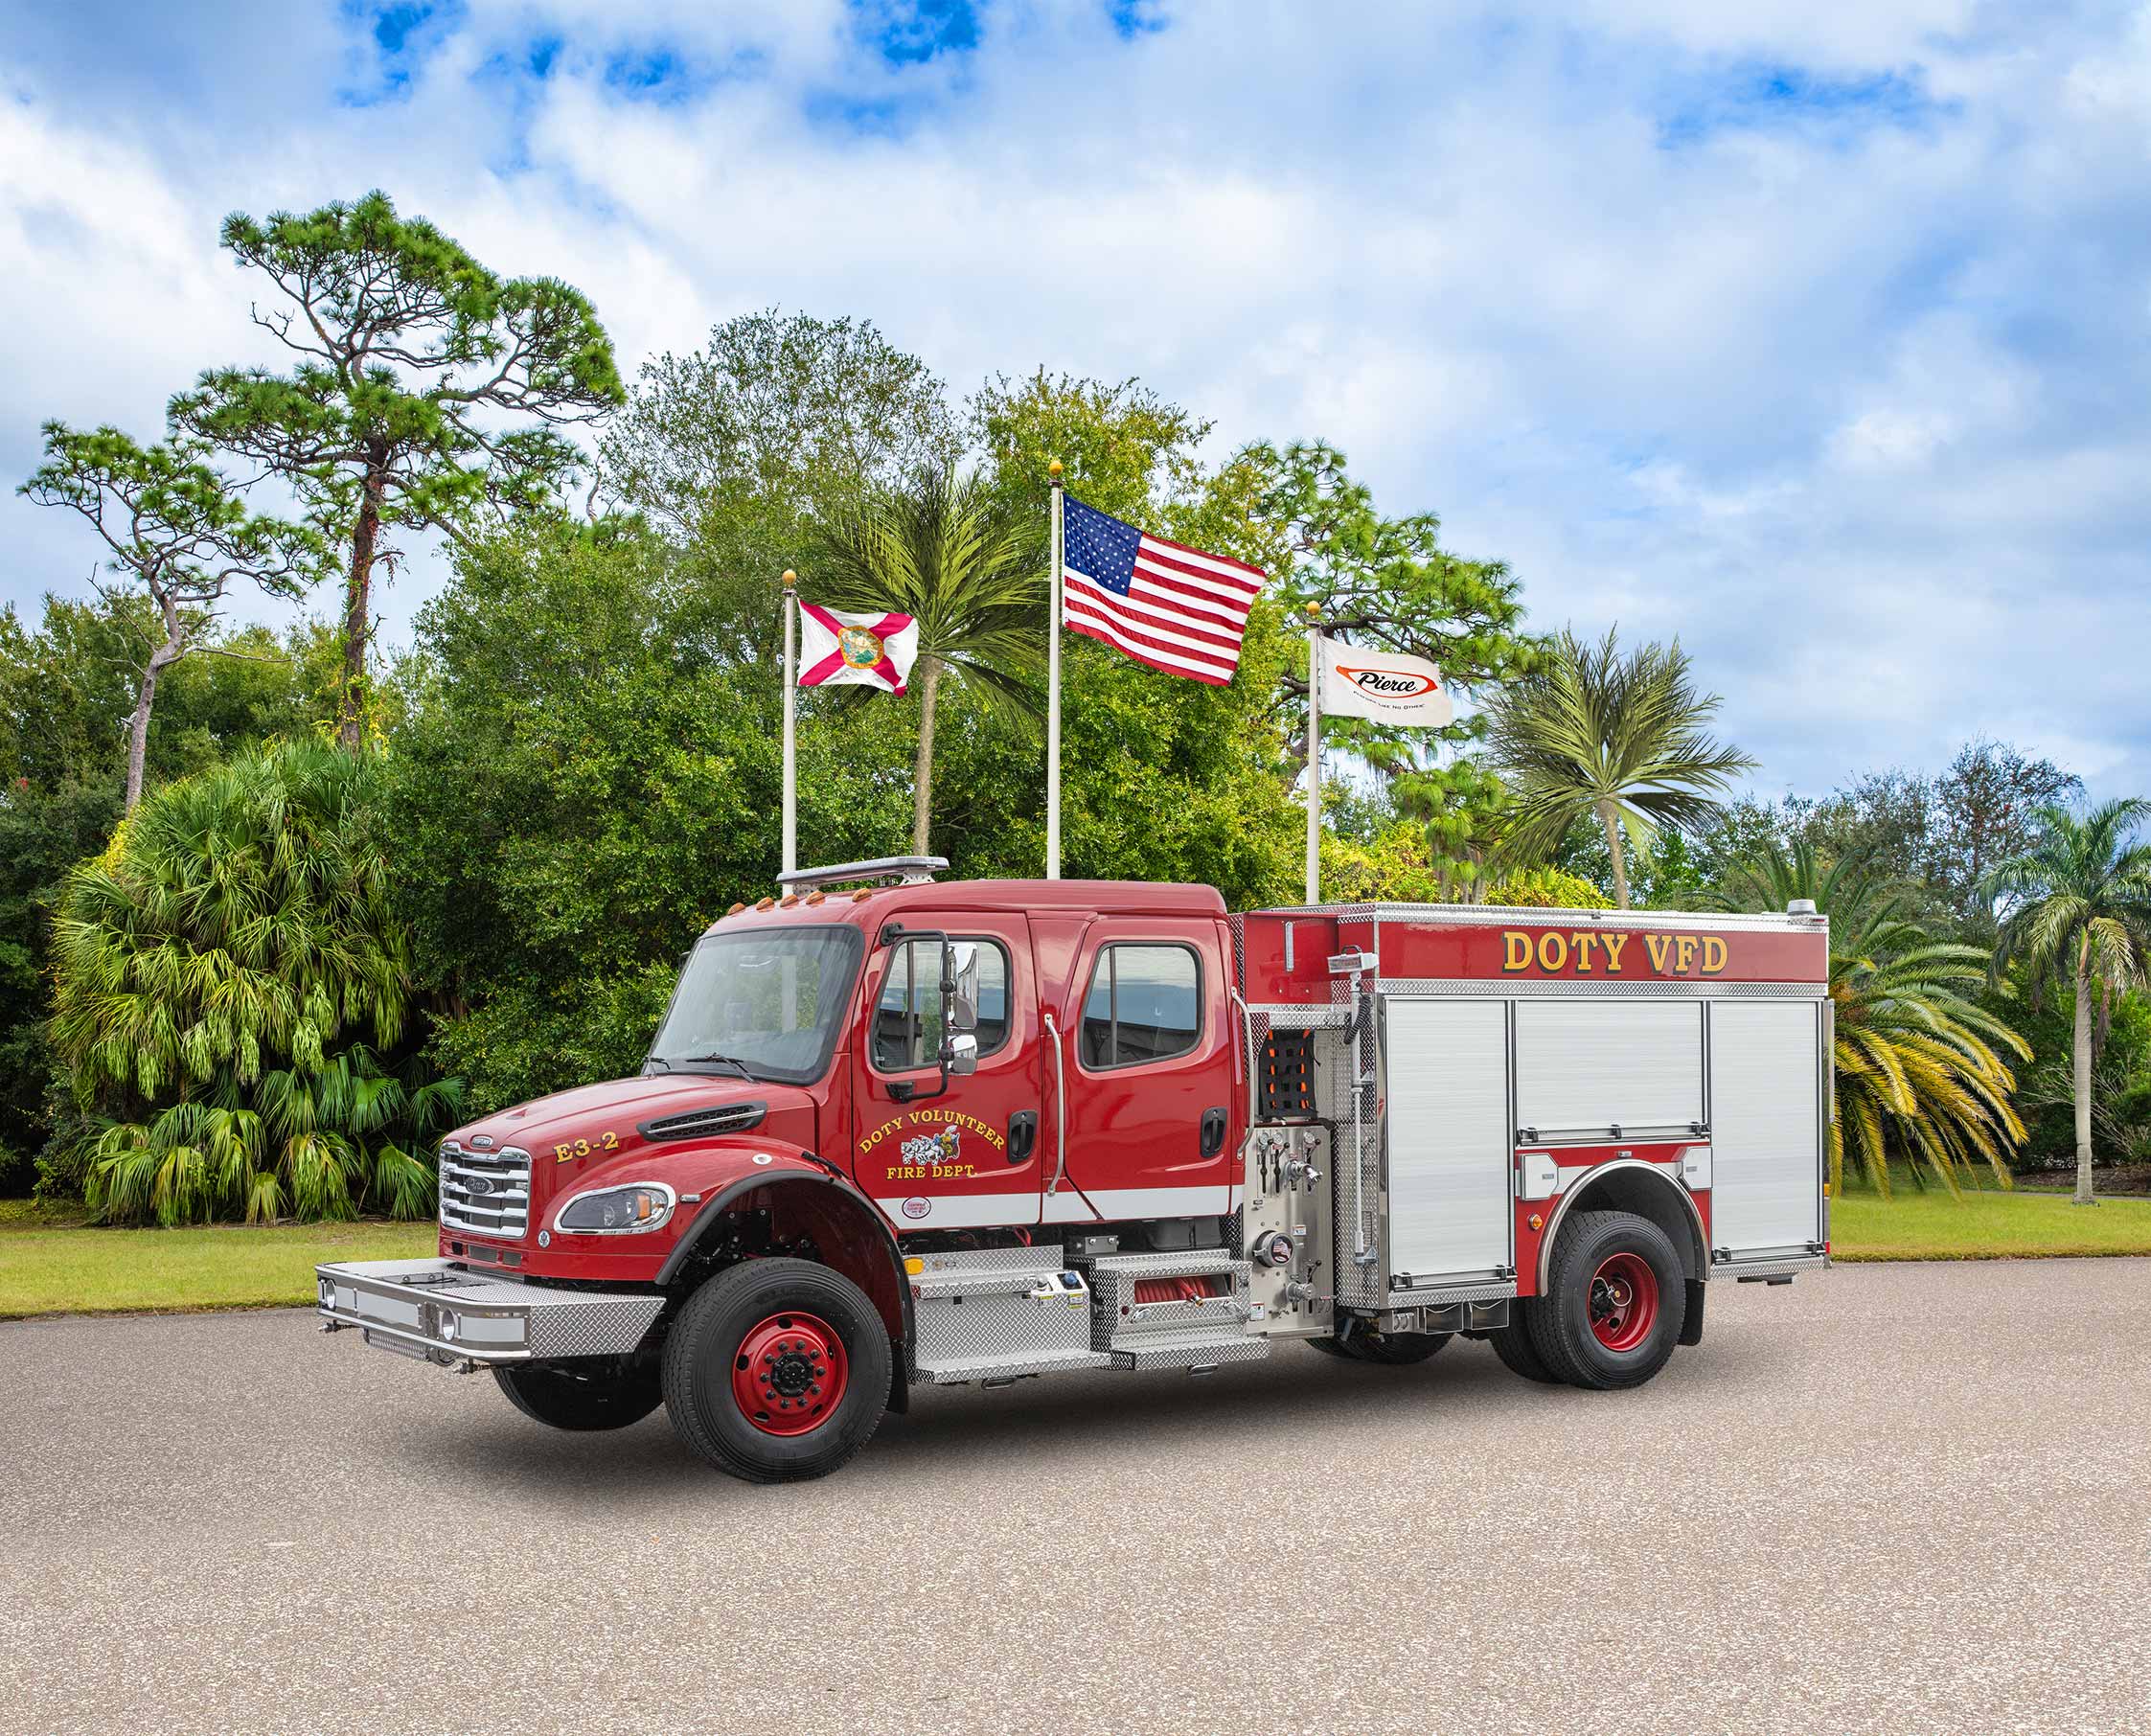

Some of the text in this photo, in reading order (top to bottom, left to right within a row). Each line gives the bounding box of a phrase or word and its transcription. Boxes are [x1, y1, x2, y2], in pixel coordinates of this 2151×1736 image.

[1358, 672, 1416, 692] Pierce
[1503, 931, 1728, 975] DOTY VFD
[554, 1131, 619, 1164] E3-2
[859, 1109, 1005, 1154] DOTY VOLUNTEER
[887, 1164, 978, 1179] FIRE DEPT.
